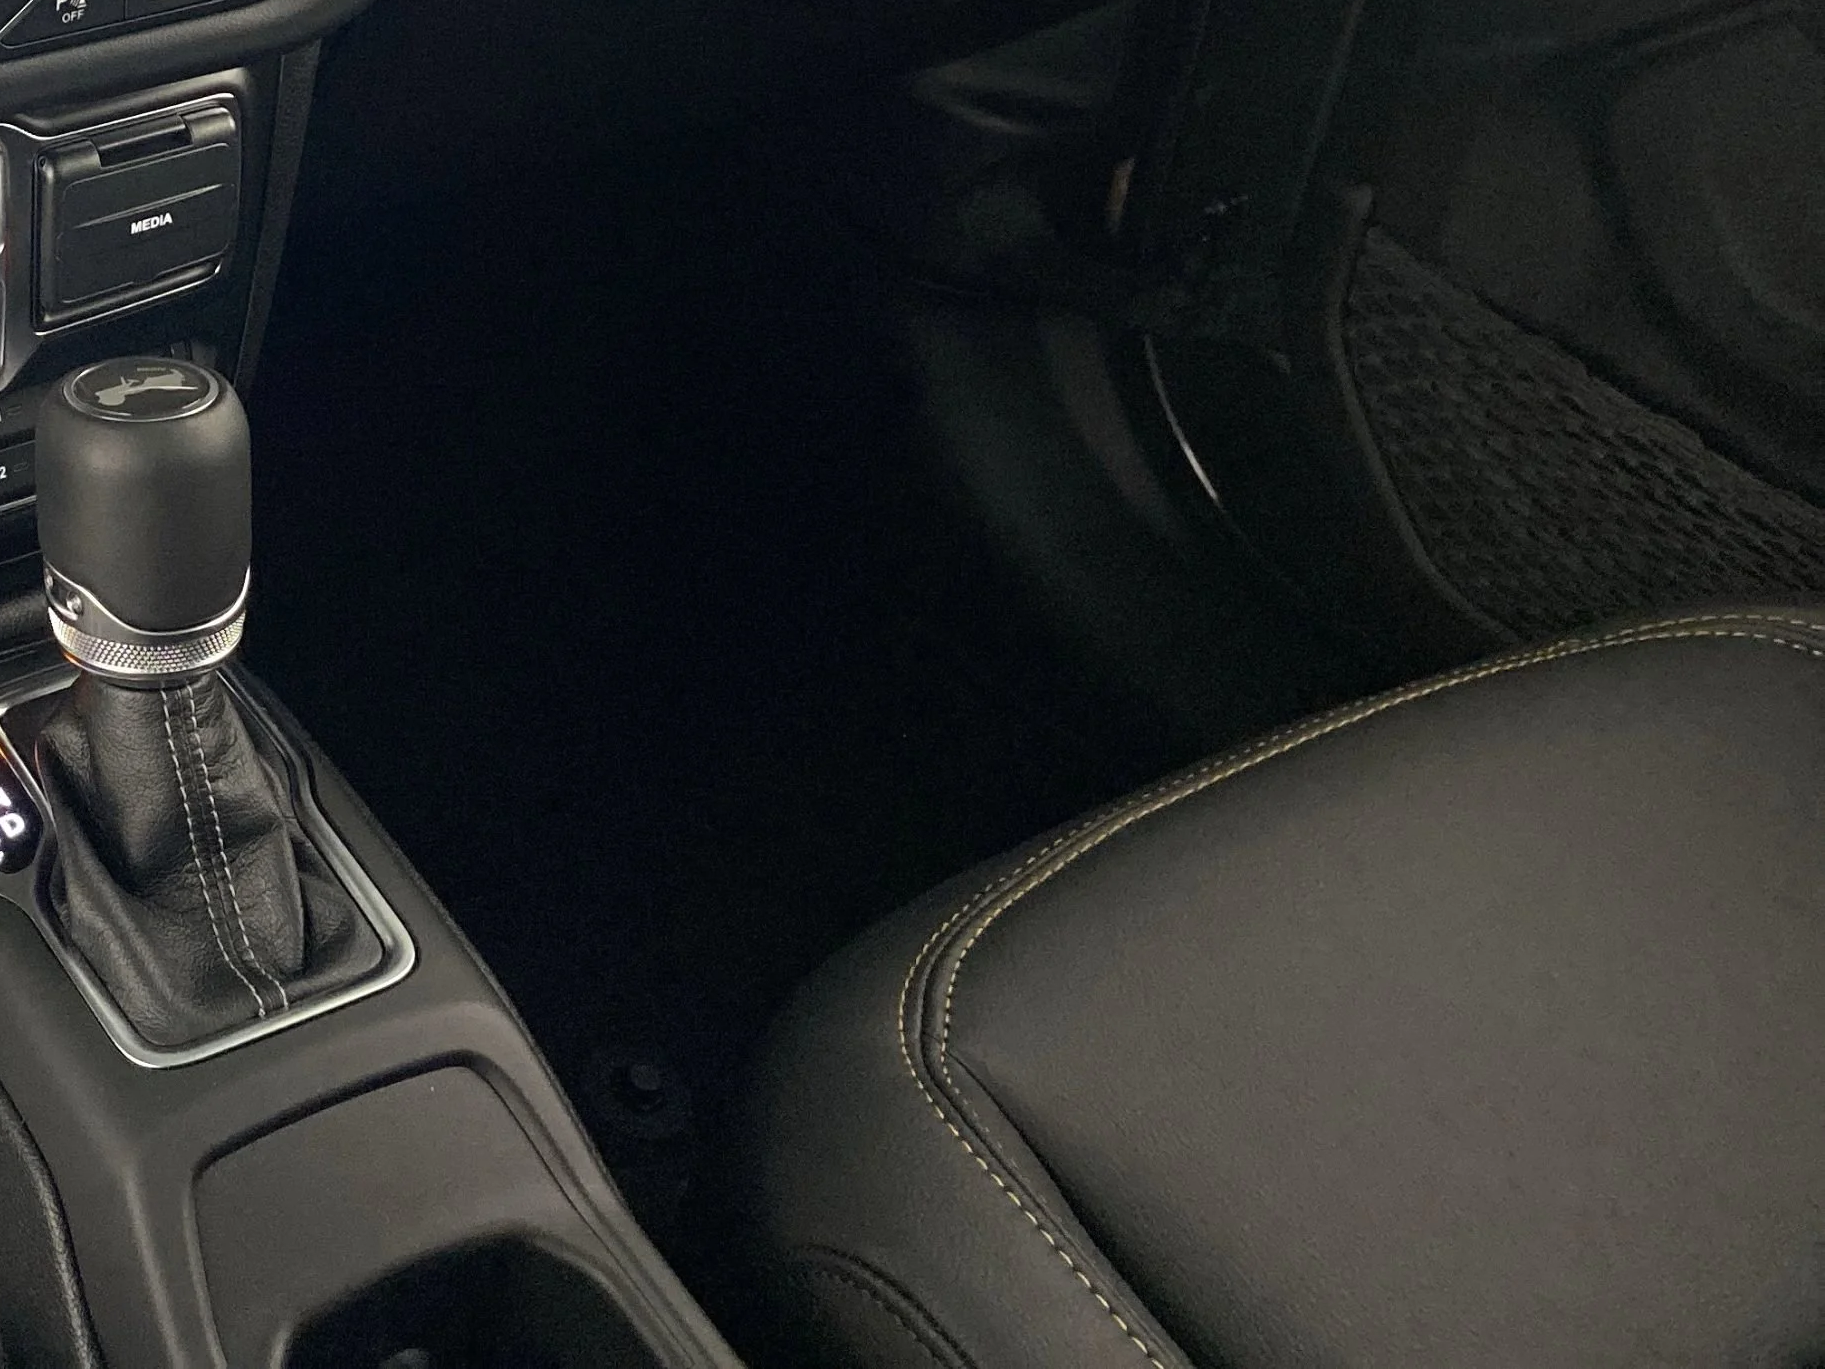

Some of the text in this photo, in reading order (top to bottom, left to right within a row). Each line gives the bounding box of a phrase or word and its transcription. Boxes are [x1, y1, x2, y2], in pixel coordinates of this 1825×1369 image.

[61, 7, 86, 24] OFF
[130, 212, 174, 235] MEDIA
[0, 812, 26, 841] D
